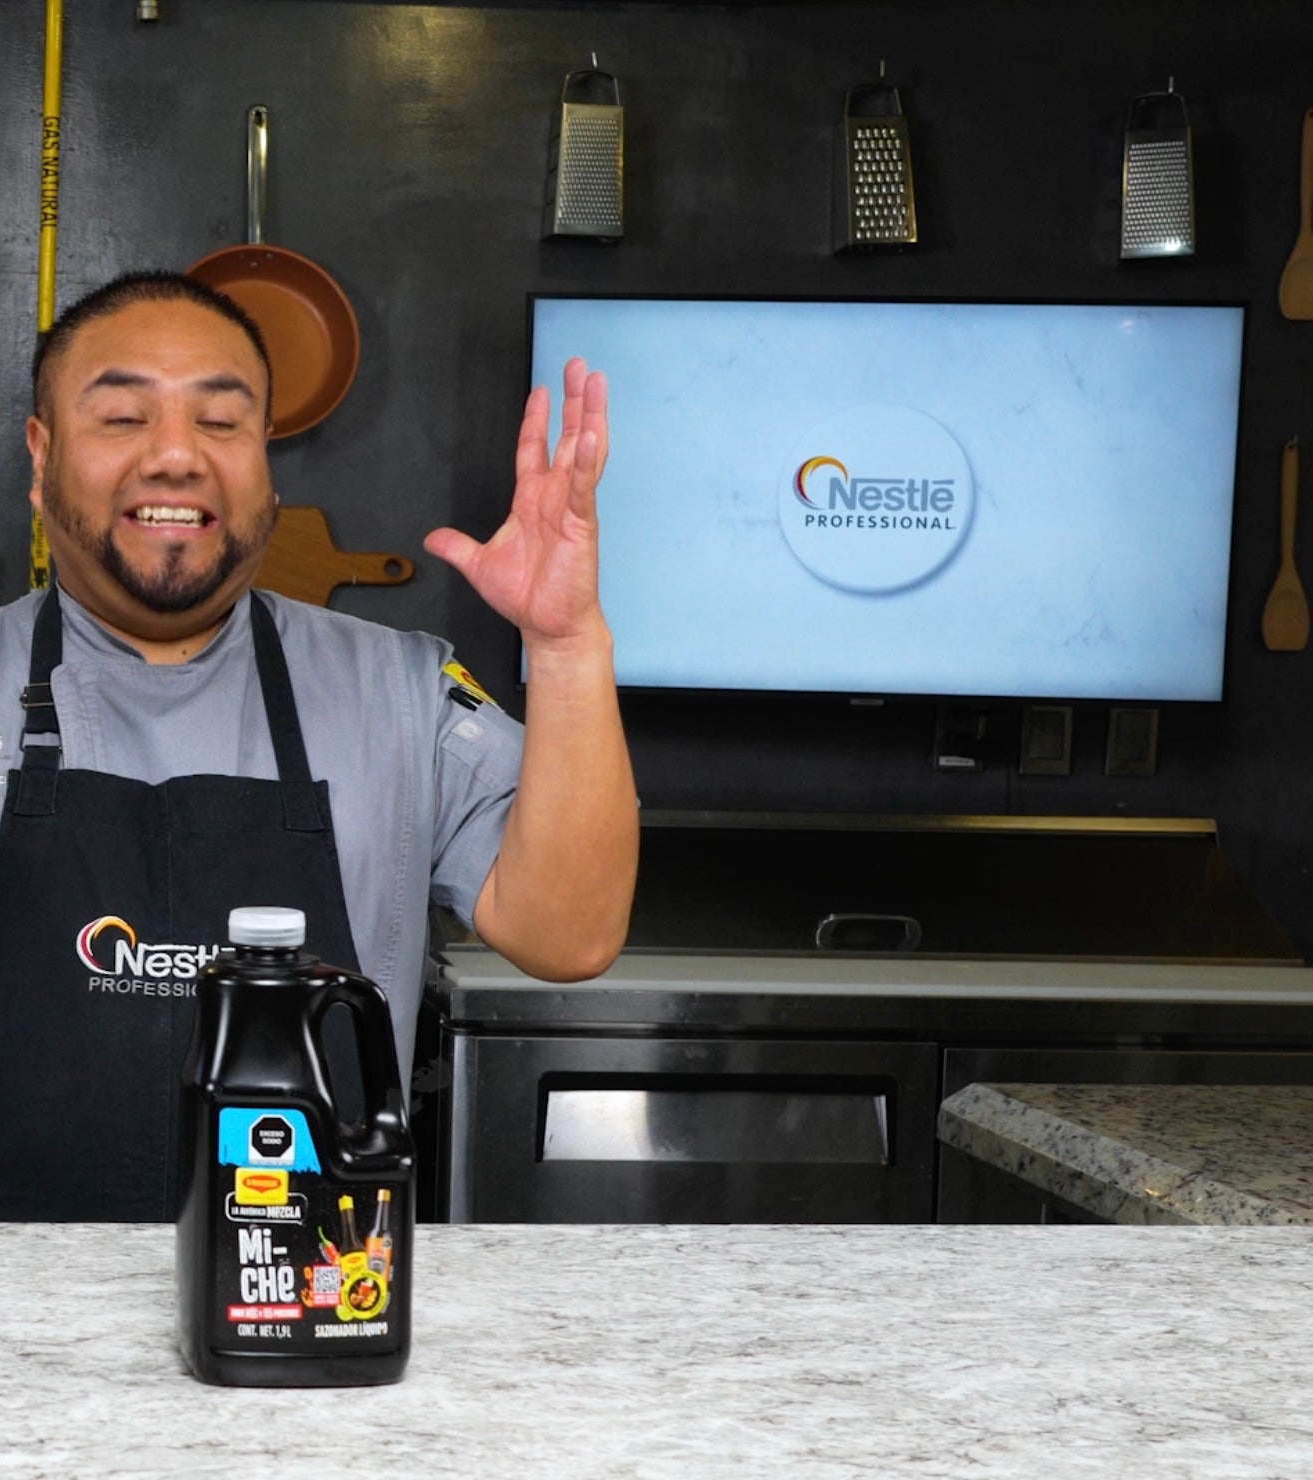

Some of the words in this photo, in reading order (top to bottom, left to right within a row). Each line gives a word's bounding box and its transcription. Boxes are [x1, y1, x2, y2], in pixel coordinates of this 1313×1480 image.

[43, 116, 60, 150] GAS
[40, 156, 59, 232] NATURAL
[828, 476, 955, 513] Nestlé
[805, 514, 954, 531] PROFESSIONAL
